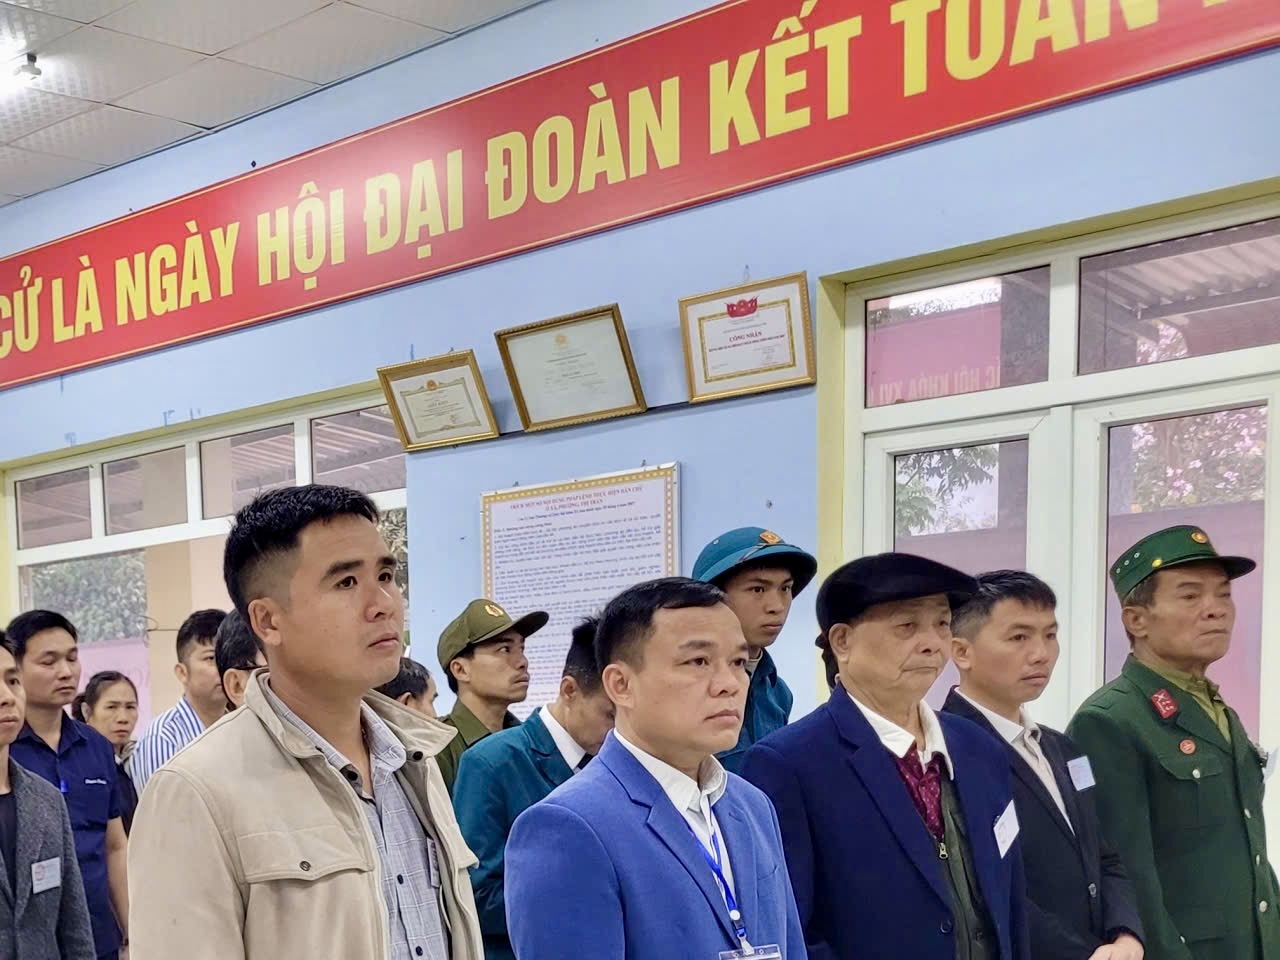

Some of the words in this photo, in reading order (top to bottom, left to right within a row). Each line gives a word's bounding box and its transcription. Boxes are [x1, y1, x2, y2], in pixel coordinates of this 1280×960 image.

[51, 254, 104, 344] LÀ
[114, 219, 241, 326] NGÀY
[256, 181, 345, 291] HỘI
[363, 149, 464, 260] ĐẠI
[484, 75, 680, 220] ĐOÀN
[709, 0, 862, 155] KẾT
